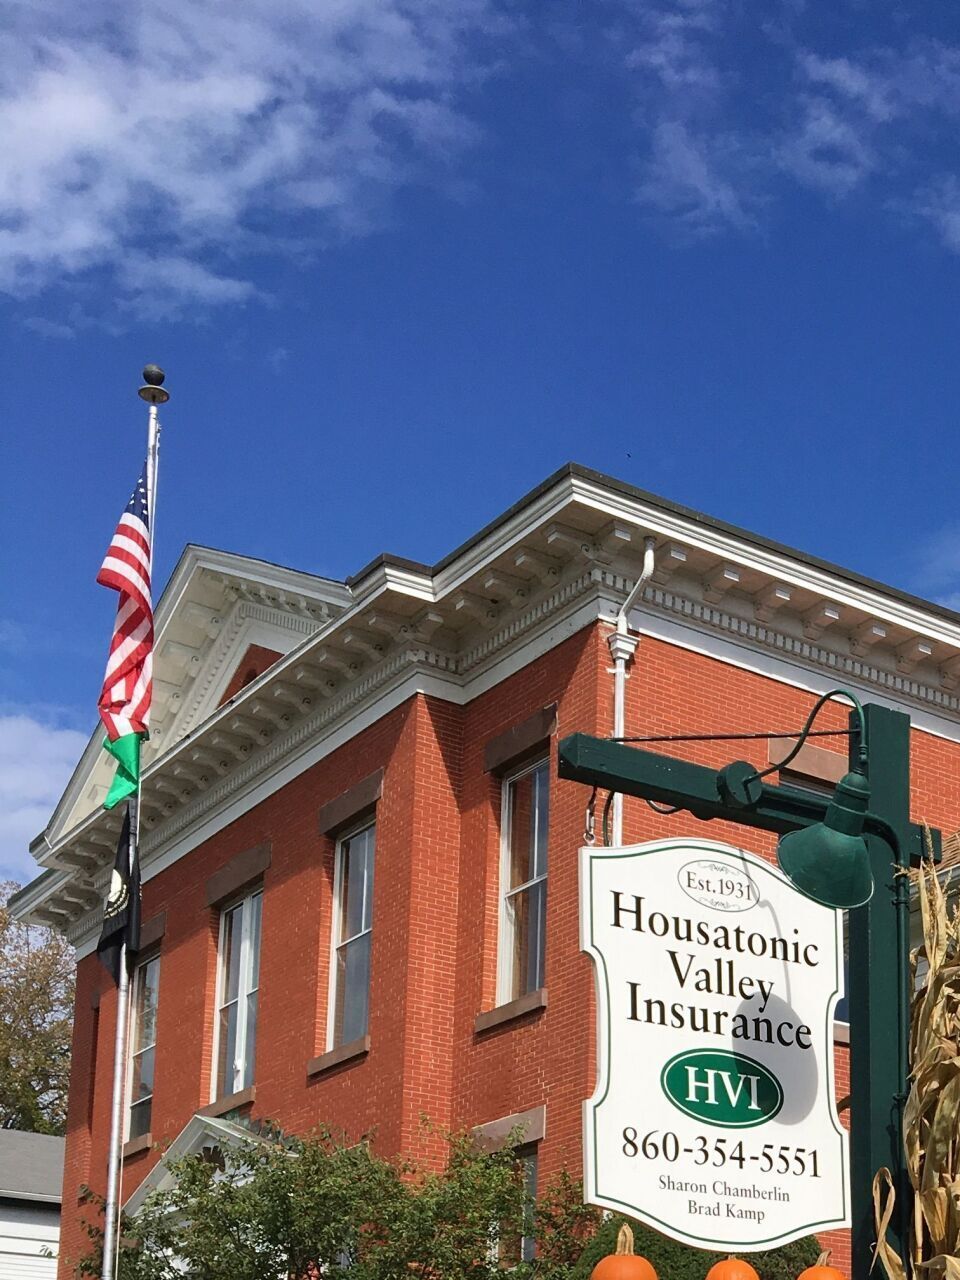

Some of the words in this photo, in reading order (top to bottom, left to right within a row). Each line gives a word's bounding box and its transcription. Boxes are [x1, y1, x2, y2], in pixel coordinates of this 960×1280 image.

[610, 890, 819, 967] Housatonic
[666, 950, 774, 1012] Valley
[626, 982, 812, 1049] Insurance
[685, 1065, 761, 1110] HVI
[622, 1127, 821, 1177] 860-354-5551
[658, 1175, 707, 1194] Sharon
[712, 1181, 790, 1202] Chamberlin
[688, 1200, 720, 1217] Brad
[725, 1204, 765, 1222] Kamp
